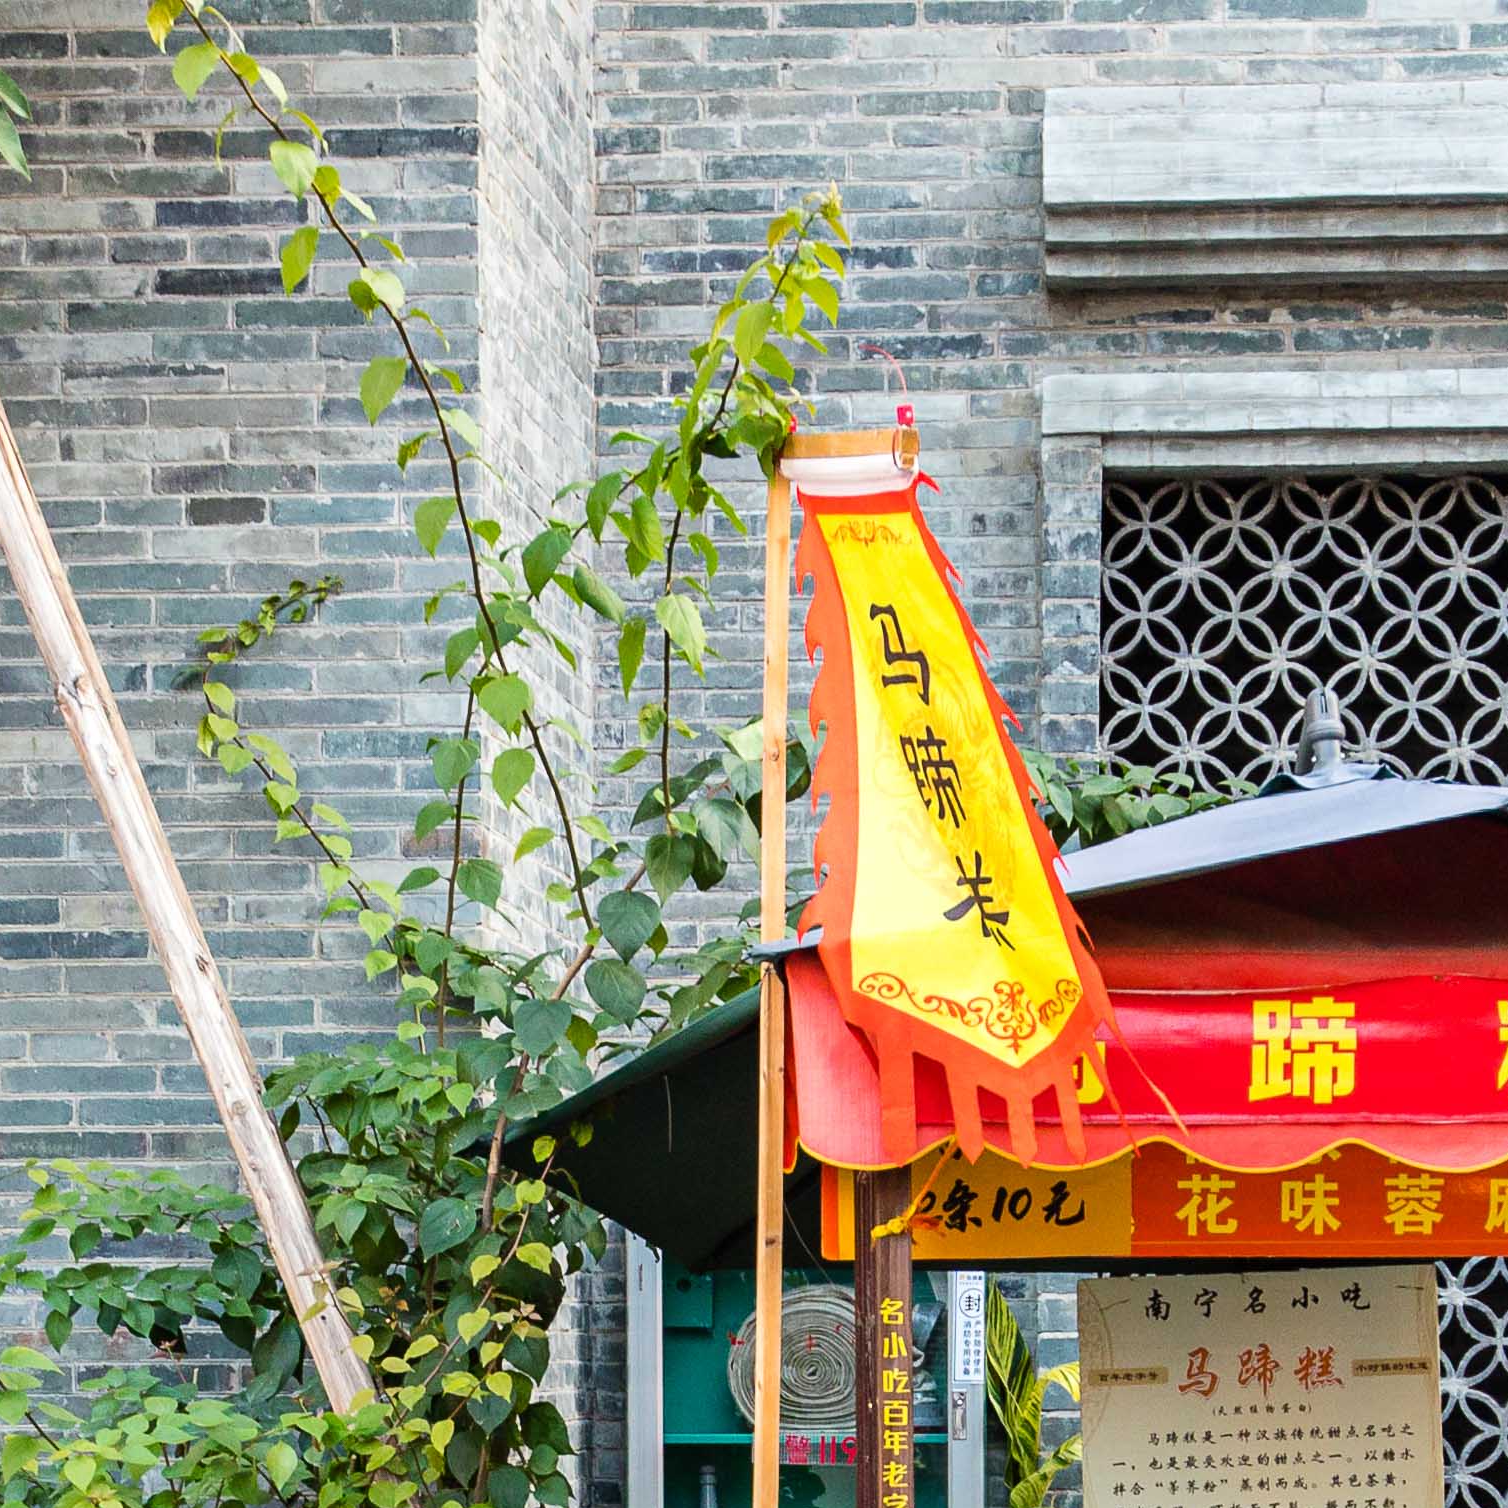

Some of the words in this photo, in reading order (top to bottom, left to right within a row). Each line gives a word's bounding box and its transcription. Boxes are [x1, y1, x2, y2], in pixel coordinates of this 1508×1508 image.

[965, 1294, 982, 1312] 封
[1145, 1282, 1371, 1320] 南宁名小吃
[1178, 1343, 1343, 1399] 马蹄糕
